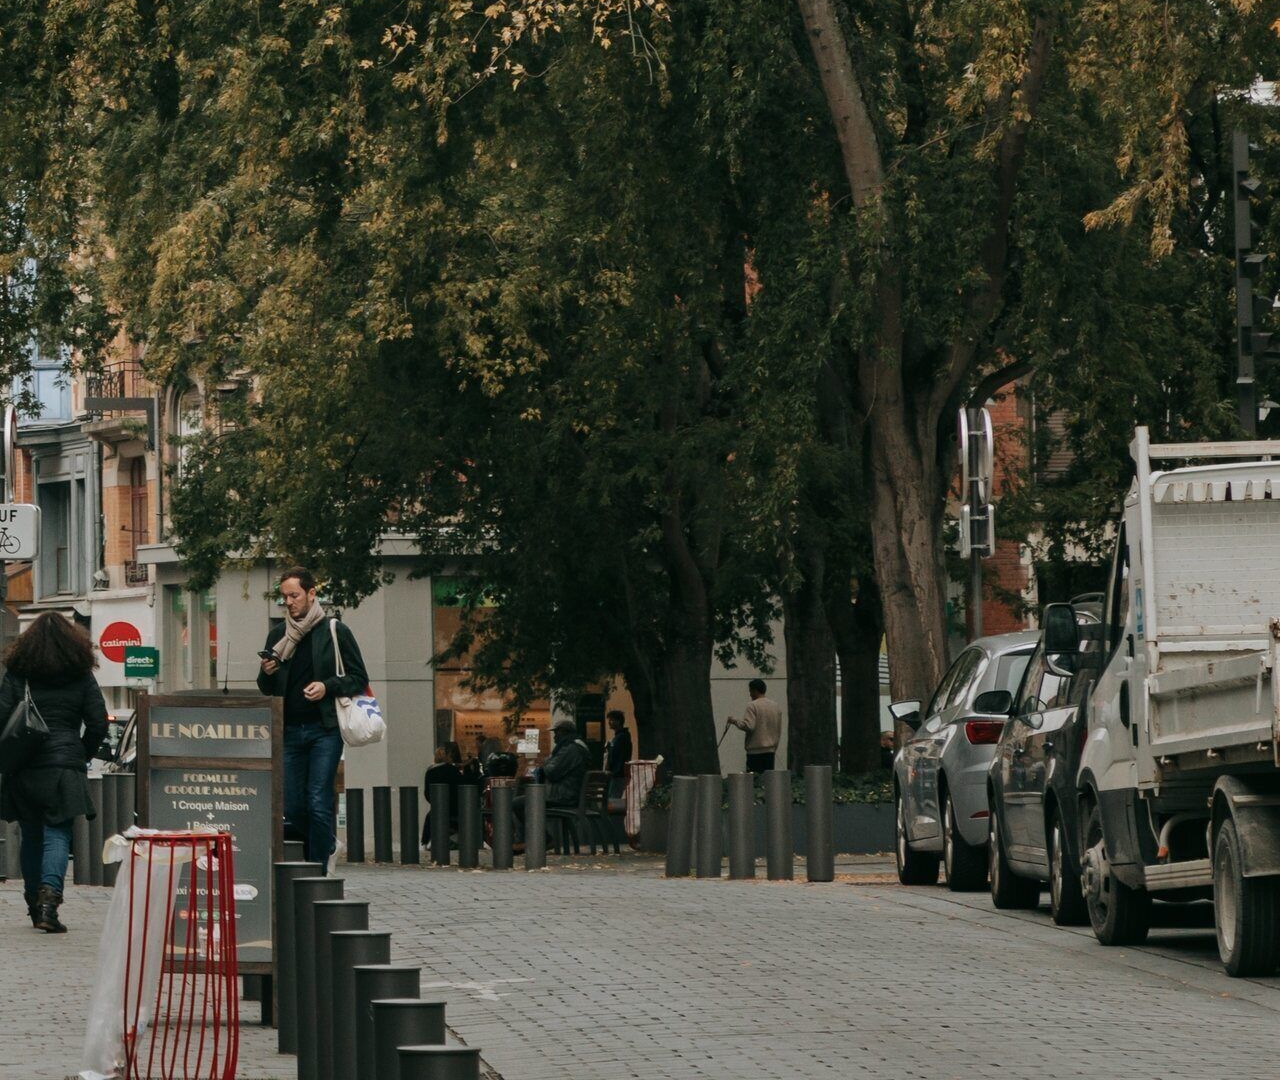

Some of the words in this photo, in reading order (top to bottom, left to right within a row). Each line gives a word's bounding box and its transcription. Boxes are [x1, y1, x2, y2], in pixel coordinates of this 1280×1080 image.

[102, 638, 141, 648] catimini
[151, 723, 175, 738] LE
[178, 723, 271, 741] NOAILLES
[183, 773, 238, 783] FORMULE
[164, 785, 211, 795] CROQUE
[212, 786, 257, 795] MAISON
[172, 801, 176, 809] 1
[179, 801, 213, 811] Croque
[215, 801, 249, 811] Maison
[187, 821, 190, 830] 1
